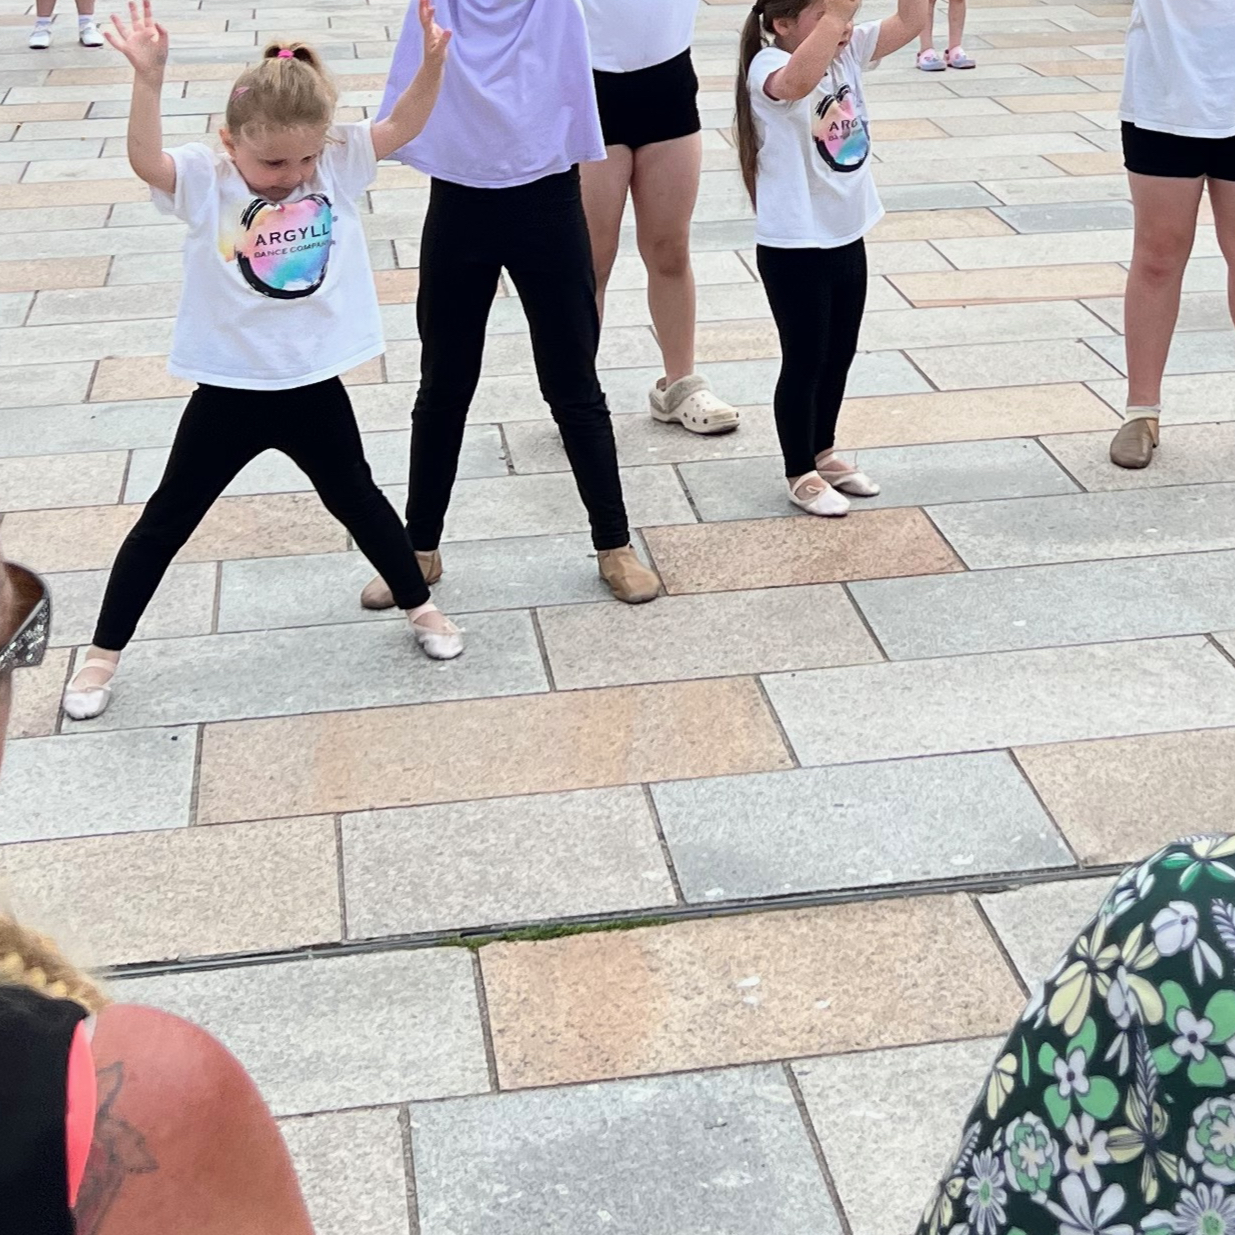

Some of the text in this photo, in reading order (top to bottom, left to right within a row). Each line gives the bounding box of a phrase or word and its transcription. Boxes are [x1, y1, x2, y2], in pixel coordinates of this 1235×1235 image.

[829, 118, 858, 132] ARG
[254, 223, 330, 247] ARGYLL
[254, 248, 288, 259] DANCE
